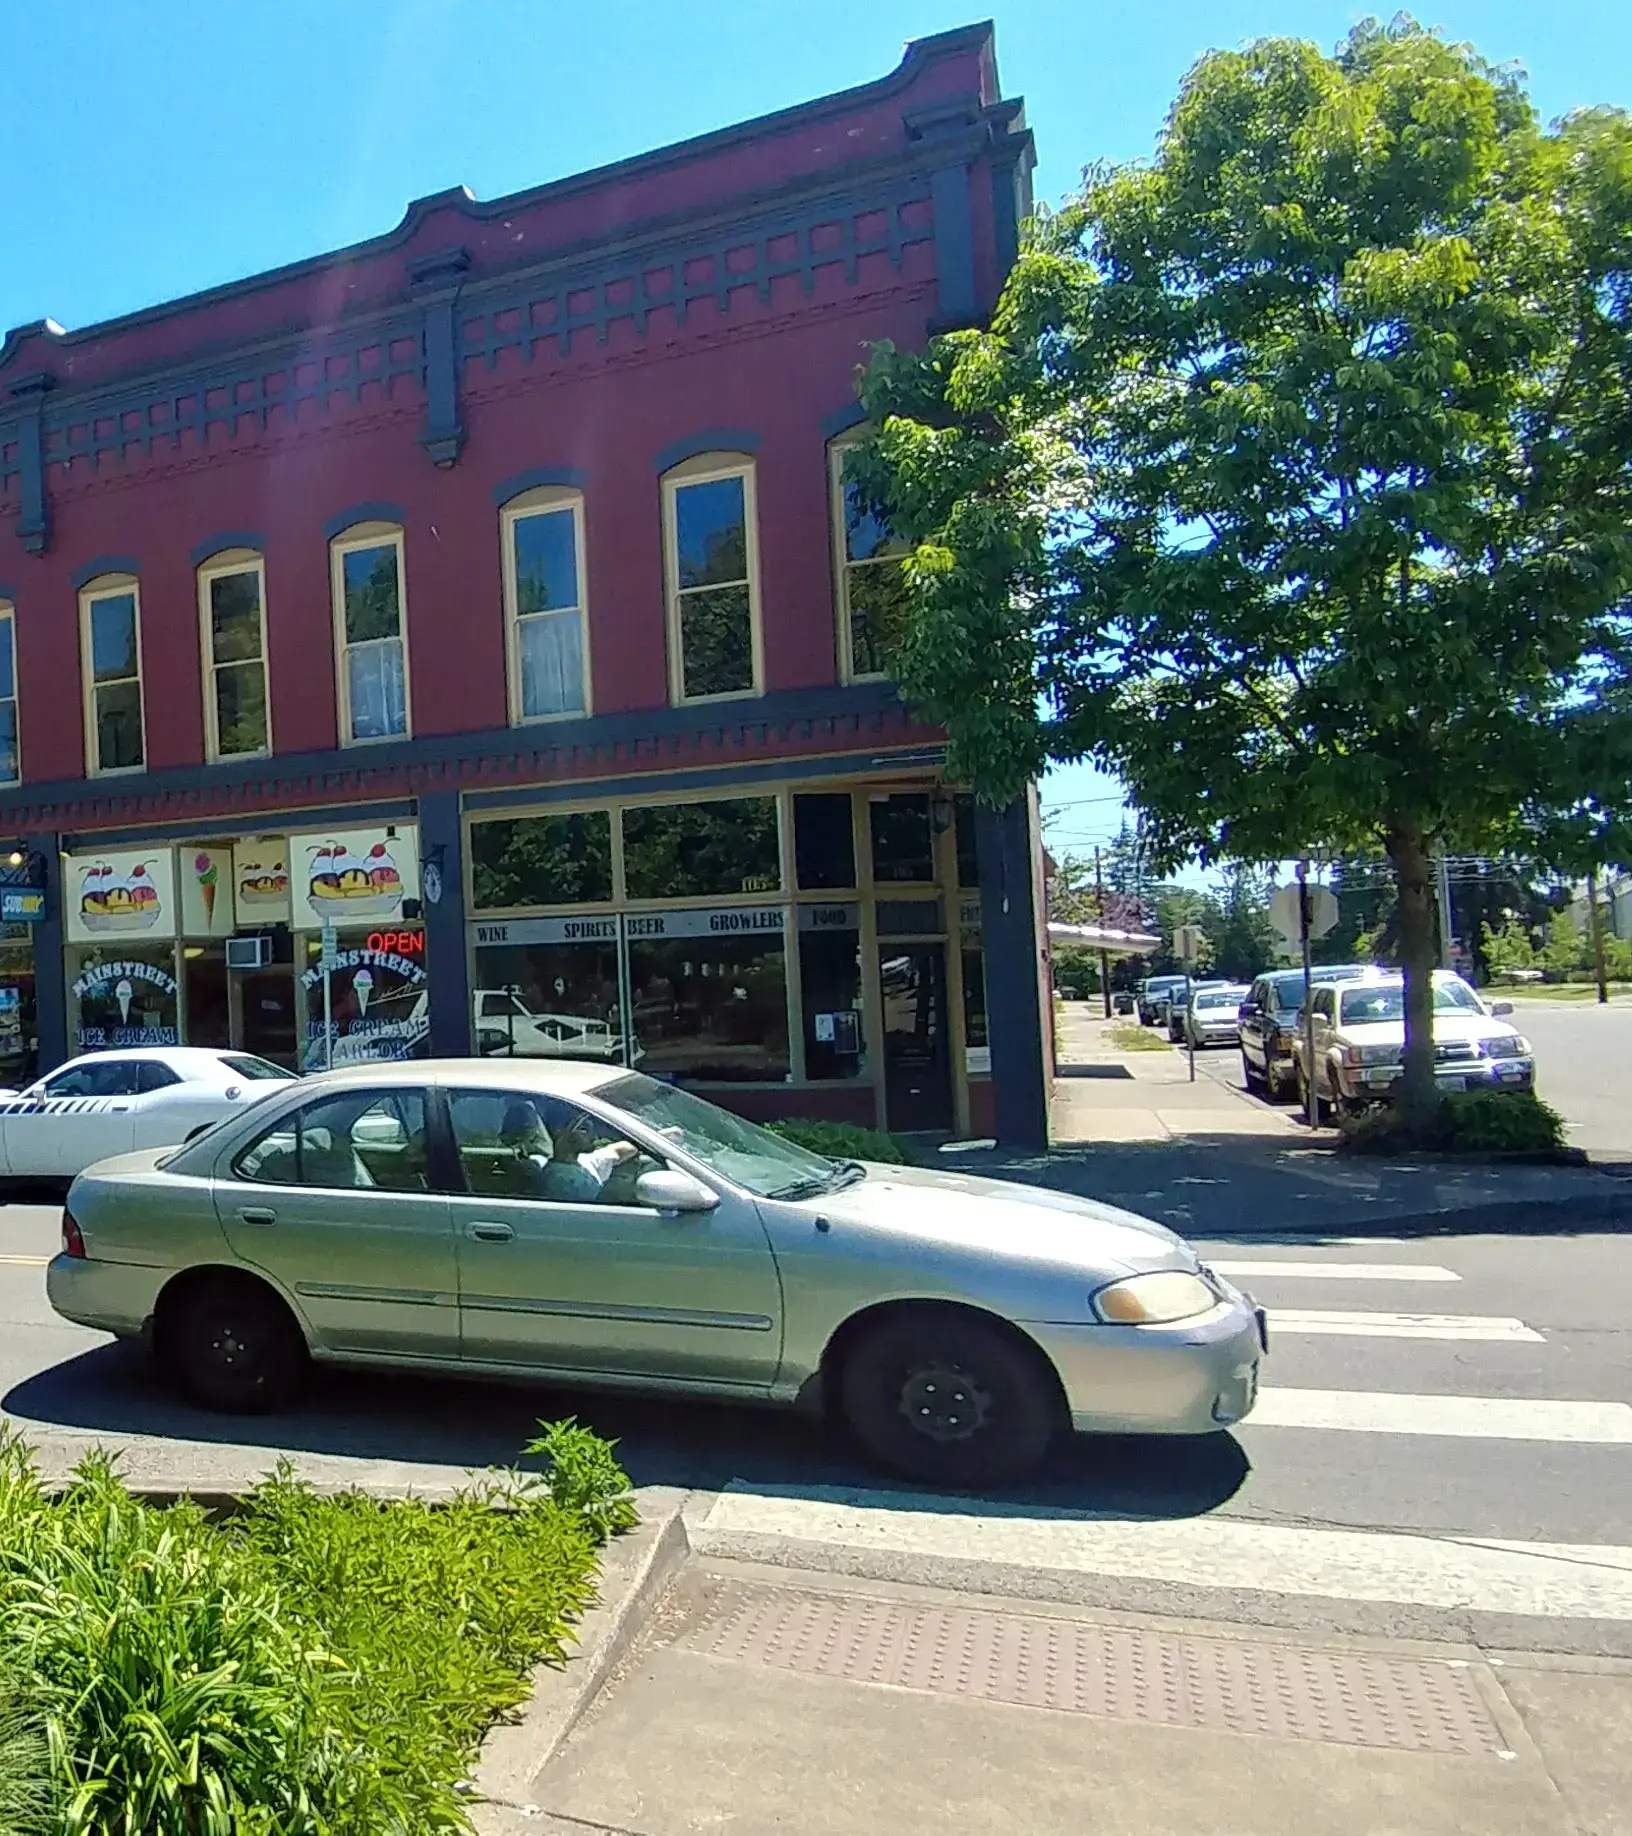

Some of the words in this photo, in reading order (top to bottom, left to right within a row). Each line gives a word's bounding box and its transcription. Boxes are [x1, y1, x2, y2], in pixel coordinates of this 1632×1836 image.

[742, 876, 768, 891] 105
[3, 895, 45, 913] SUBWAY
[477, 926, 508, 942] WINE
[564, 921, 616, 938] SPIRITS
[628, 918, 664, 935] BEER
[710, 911, 785, 931] GROWLERS
[368, 931, 424, 953] OPEN
[72, 961, 177, 998] MAINSTREET
[77, 1027, 106, 1046] ICE
[112, 1026, 176, 1045] CREAM
[325, 1041, 408, 1060] ARLOR
